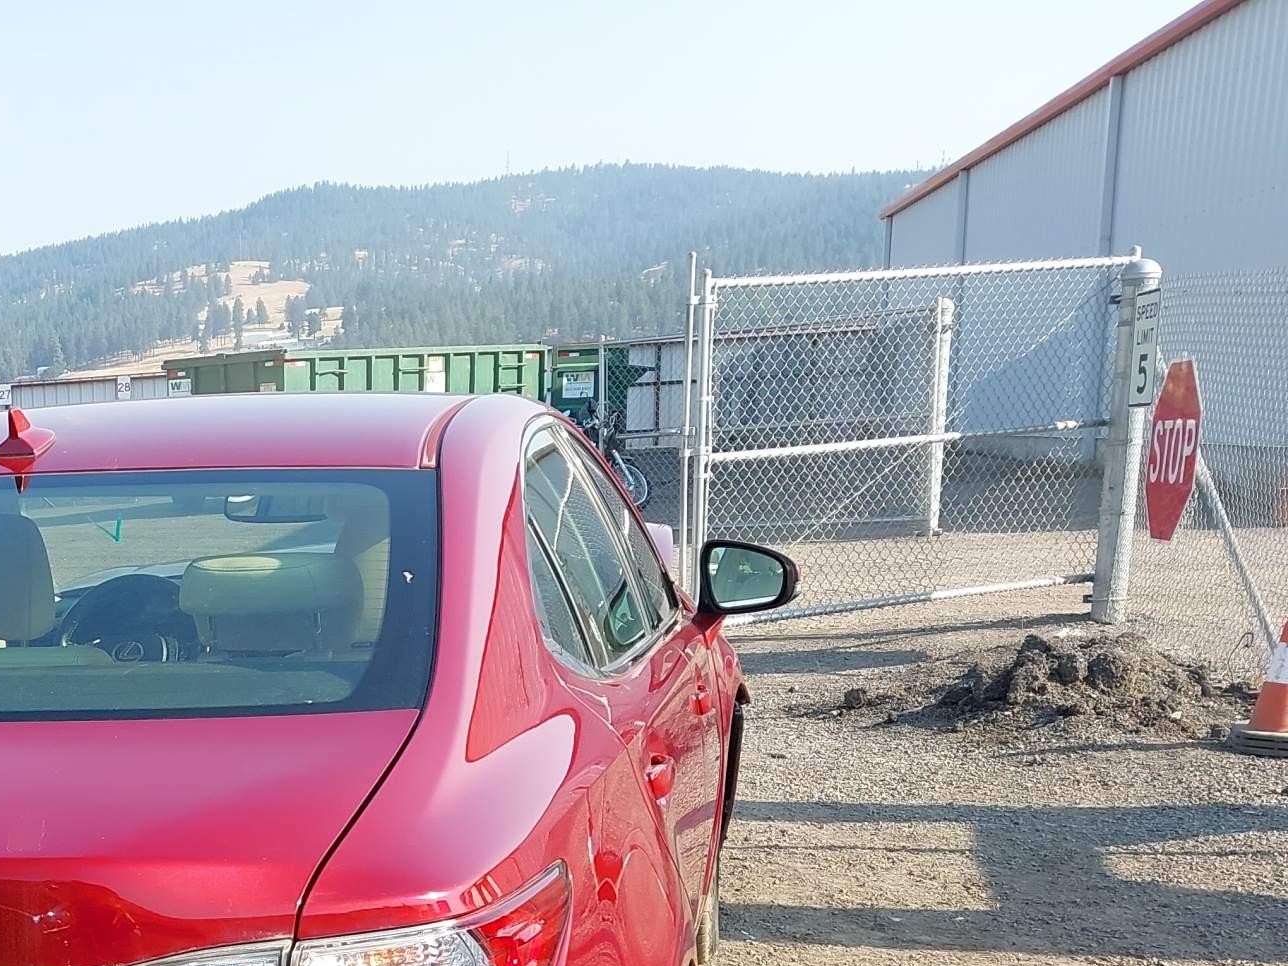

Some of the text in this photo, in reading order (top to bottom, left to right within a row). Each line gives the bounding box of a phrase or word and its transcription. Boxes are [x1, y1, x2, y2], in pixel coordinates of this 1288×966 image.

[1136, 302, 1159, 321] SPEED
[1136, 327, 1155, 346] LIMIT
[1136, 353, 1148, 394] 5
[0, 389, 11, 400] 27
[117, 382, 131, 393] 28
[1149, 418, 1197, 485] STOP
